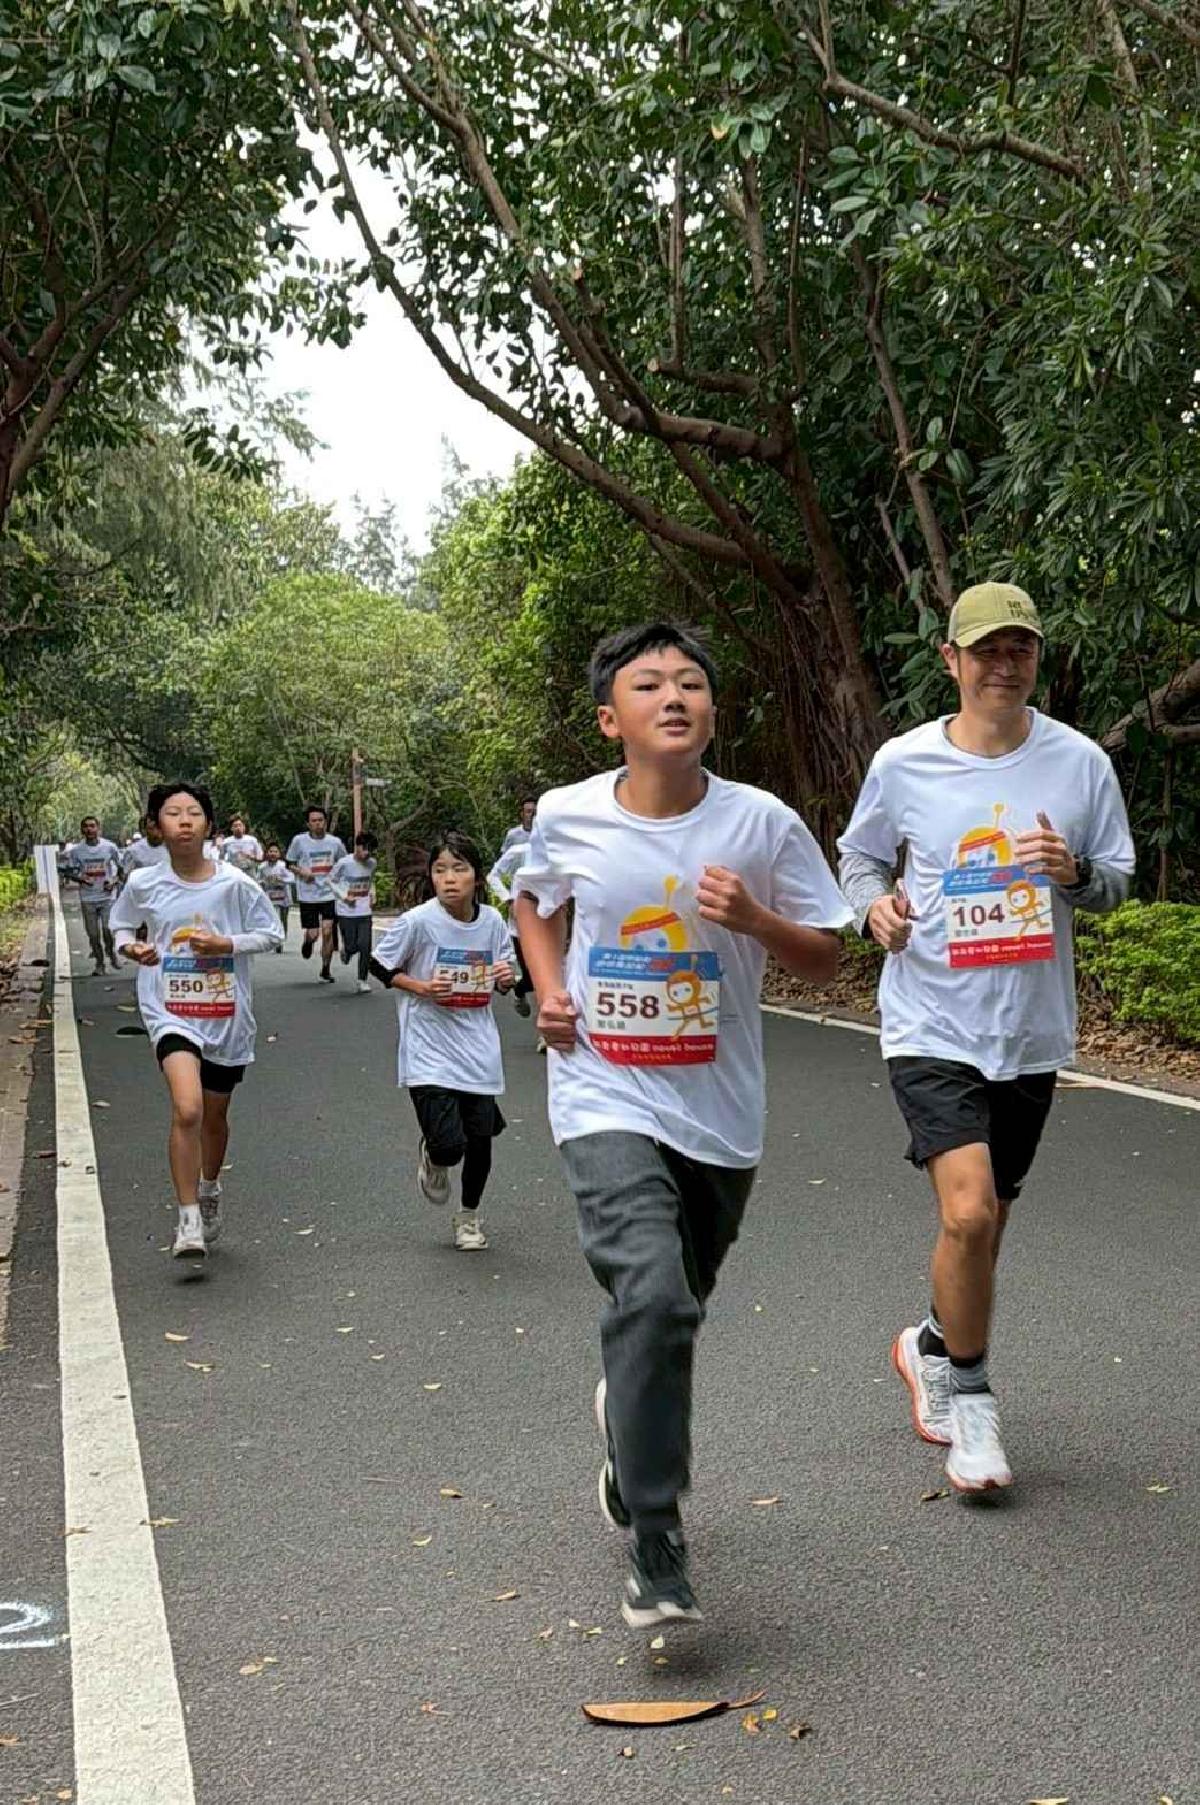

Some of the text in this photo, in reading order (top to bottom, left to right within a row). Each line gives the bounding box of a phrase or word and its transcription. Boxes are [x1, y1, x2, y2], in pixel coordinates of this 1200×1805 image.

[952, 903, 1005, 927] 104
[169, 979, 204, 993] 550
[596, 991, 660, 1019] 558
